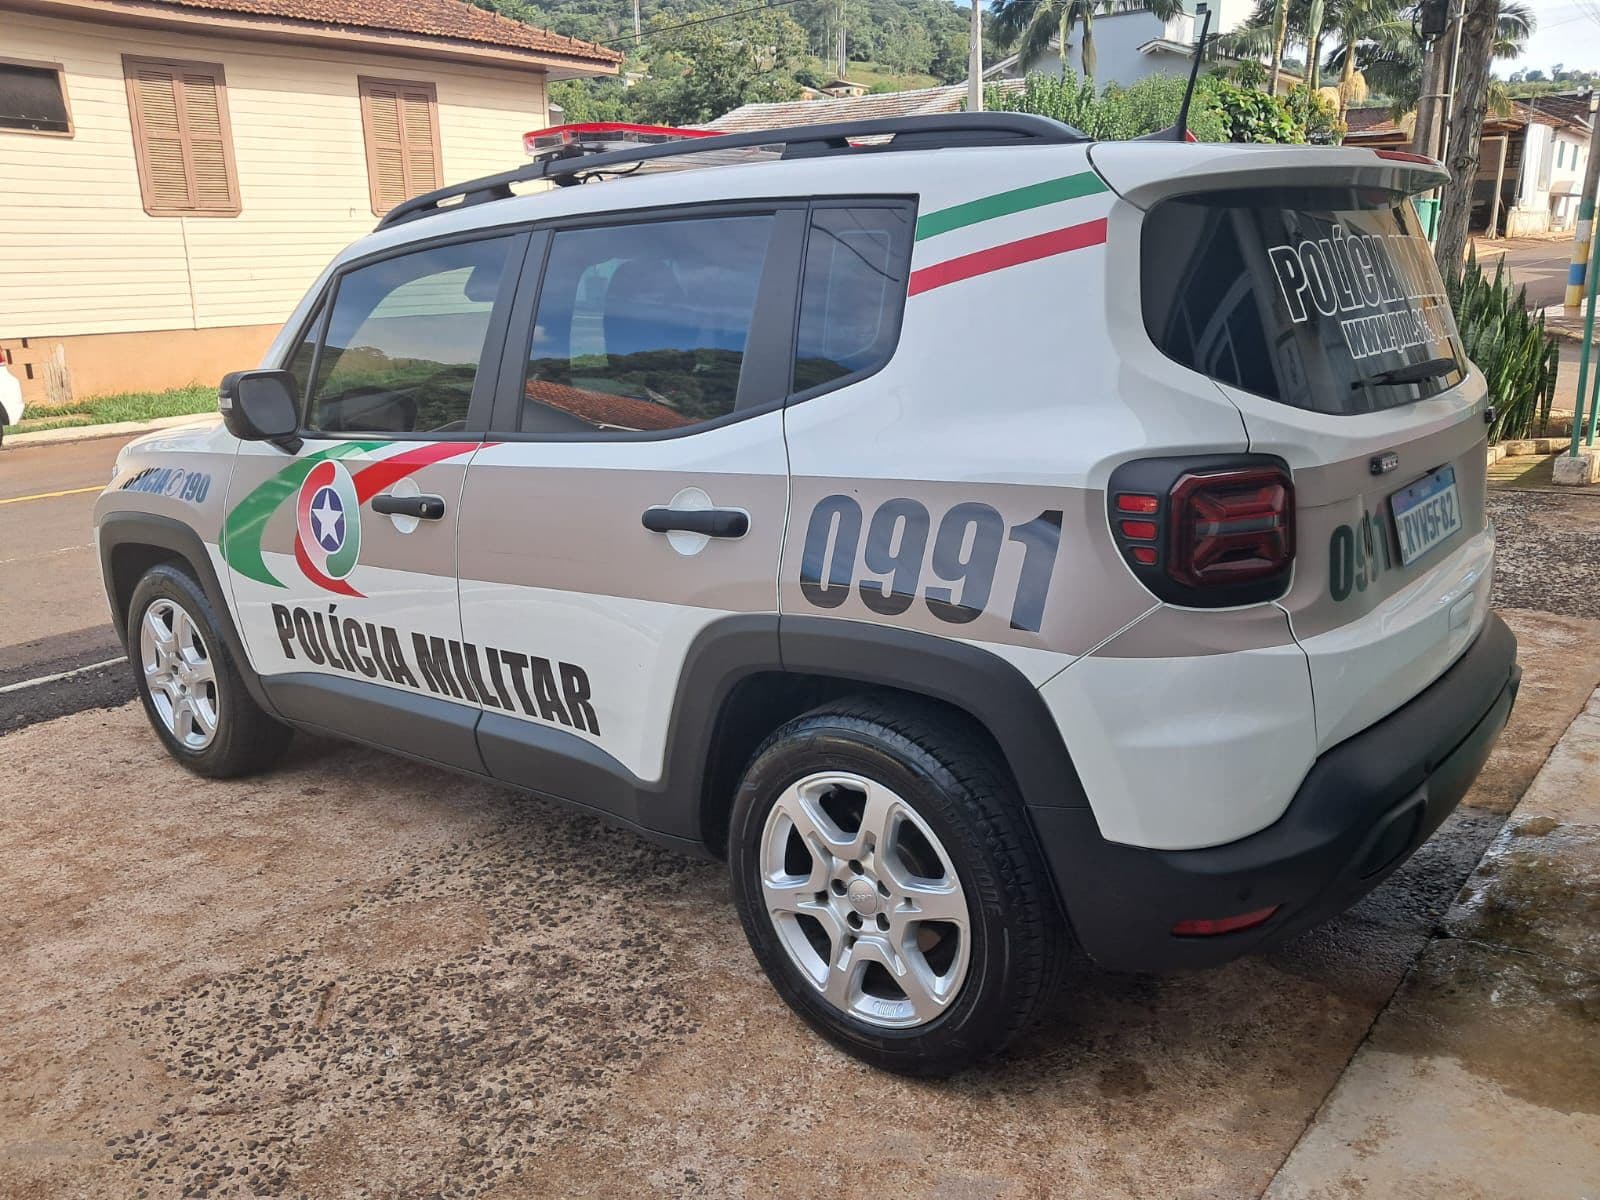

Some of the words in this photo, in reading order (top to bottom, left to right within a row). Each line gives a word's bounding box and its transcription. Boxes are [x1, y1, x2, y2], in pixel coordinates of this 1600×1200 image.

[1268, 224, 1403, 323] POLÍCIA
[178, 471, 212, 503] 190
[799, 494, 1064, 633] 0991
[271, 603, 420, 688] POLÍCIA
[411, 631, 601, 736] MILITAR
